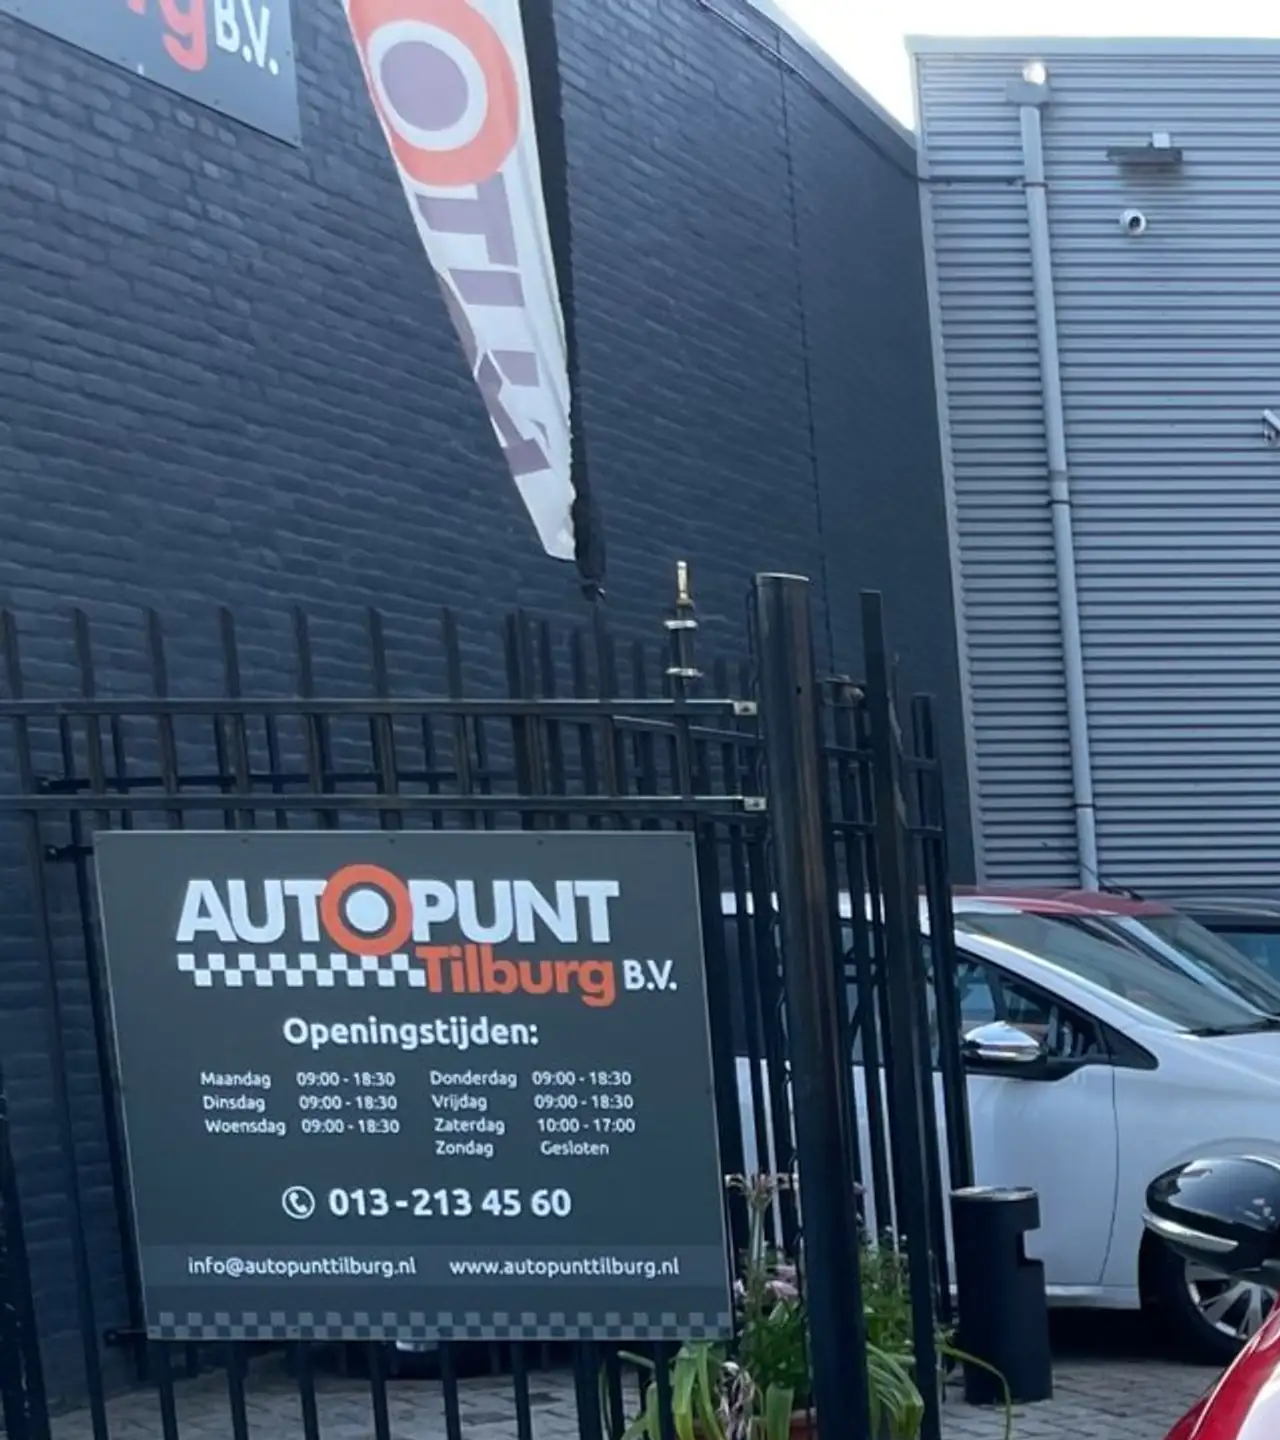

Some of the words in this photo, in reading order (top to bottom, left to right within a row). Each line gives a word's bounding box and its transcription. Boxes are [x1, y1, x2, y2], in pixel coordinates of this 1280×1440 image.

[176, 863, 620, 957] AUTOPUNT
[415, 943, 616, 1008] Tilburg
[622, 959, 678, 991] B.V.
[283, 1015, 539, 1051] Openingstijden:
[200, 1070, 272, 1090] Maandag
[296, 1071, 340, 1087] 09:00
[353, 1071, 396, 1087] 18:30
[429, 1069, 518, 1089] Donderdag
[531, 1070, 576, 1086] 09:00
[589, 1070, 632, 1086] 18:30
[202, 1094, 266, 1113] Dinsdag
[299, 1095, 342, 1110] 09:00
[356, 1095, 398, 1110] 18:30
[431, 1093, 488, 1112] Vrijdag
[534, 1094, 577, 1109] 09:00
[592, 1094, 634, 1109] 18:30
[204, 1117, 287, 1137] Woensdag
[301, 1118, 344, 1134] 09:00
[357, 1118, 400, 1134] 18:30
[433, 1117, 506, 1136] Zaterdag
[537, 1117, 580, 1133] 10:00
[592, 1117, 636, 1133] 17:00
[434, 1139, 494, 1159] Zondag
[539, 1139, 610, 1156] Gesloten
[481, 1188, 522, 1217] 45
[531, 1188, 572, 1217] 60
[188, 1256, 417, 1278] info@autopunttilburg.nl
[450, 1257, 680, 1279] www.autopunttilburg.nl
